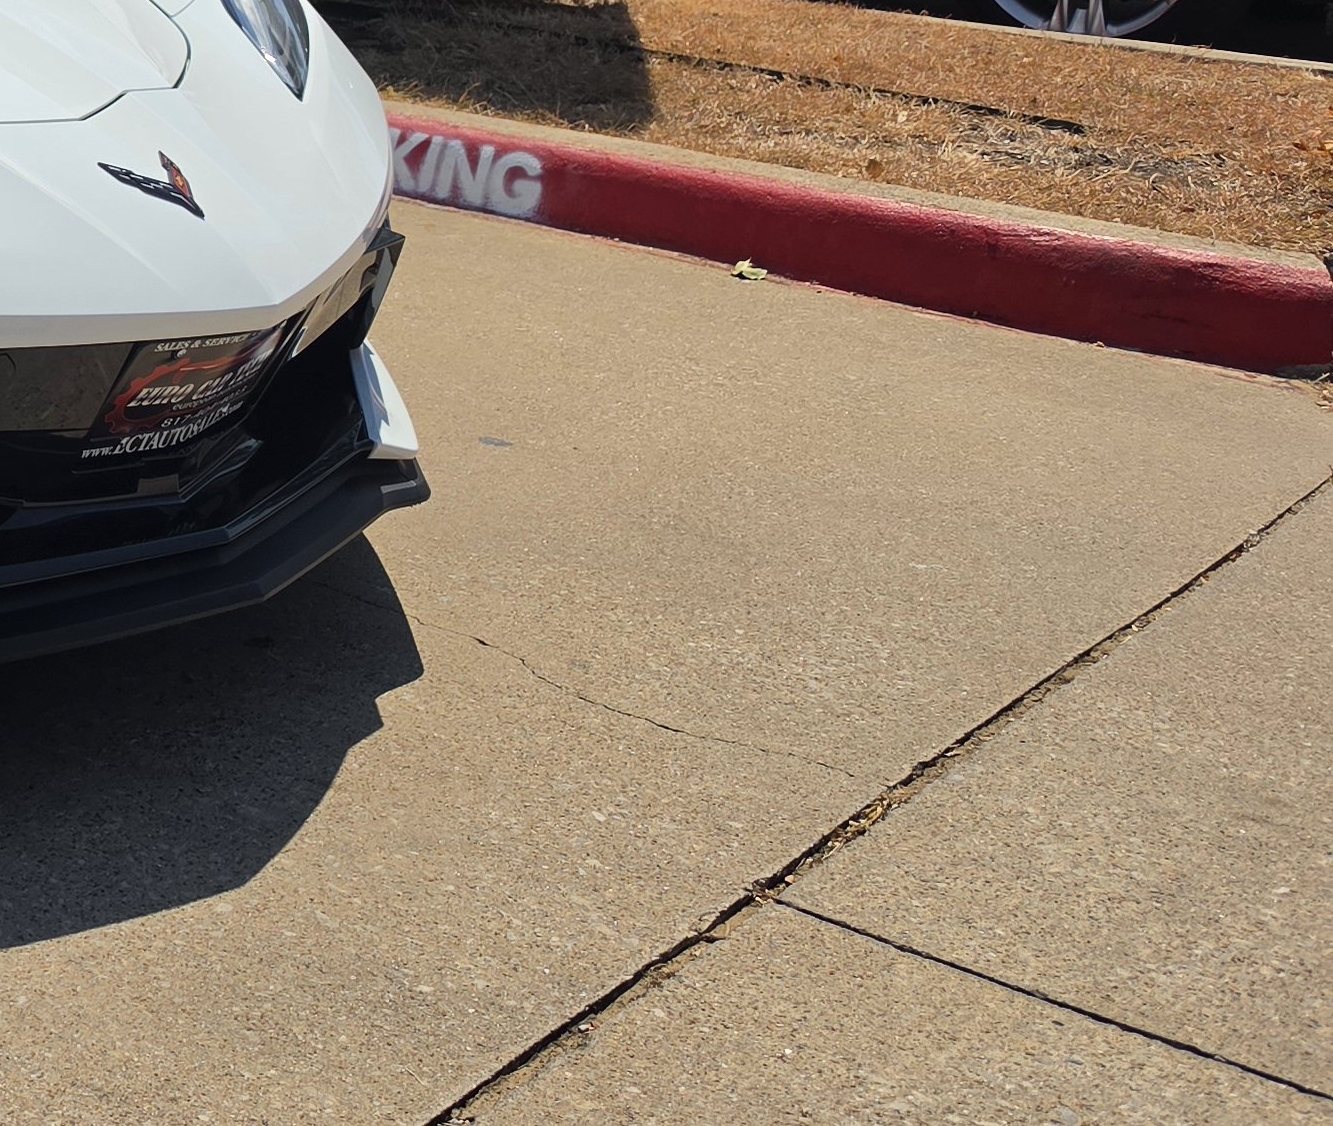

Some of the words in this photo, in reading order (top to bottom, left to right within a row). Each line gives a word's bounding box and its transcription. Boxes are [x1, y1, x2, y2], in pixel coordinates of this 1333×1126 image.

[154, 340, 192, 353] SALES
[191, 339, 202, 349] &
[127, 383, 195, 408] EURO
